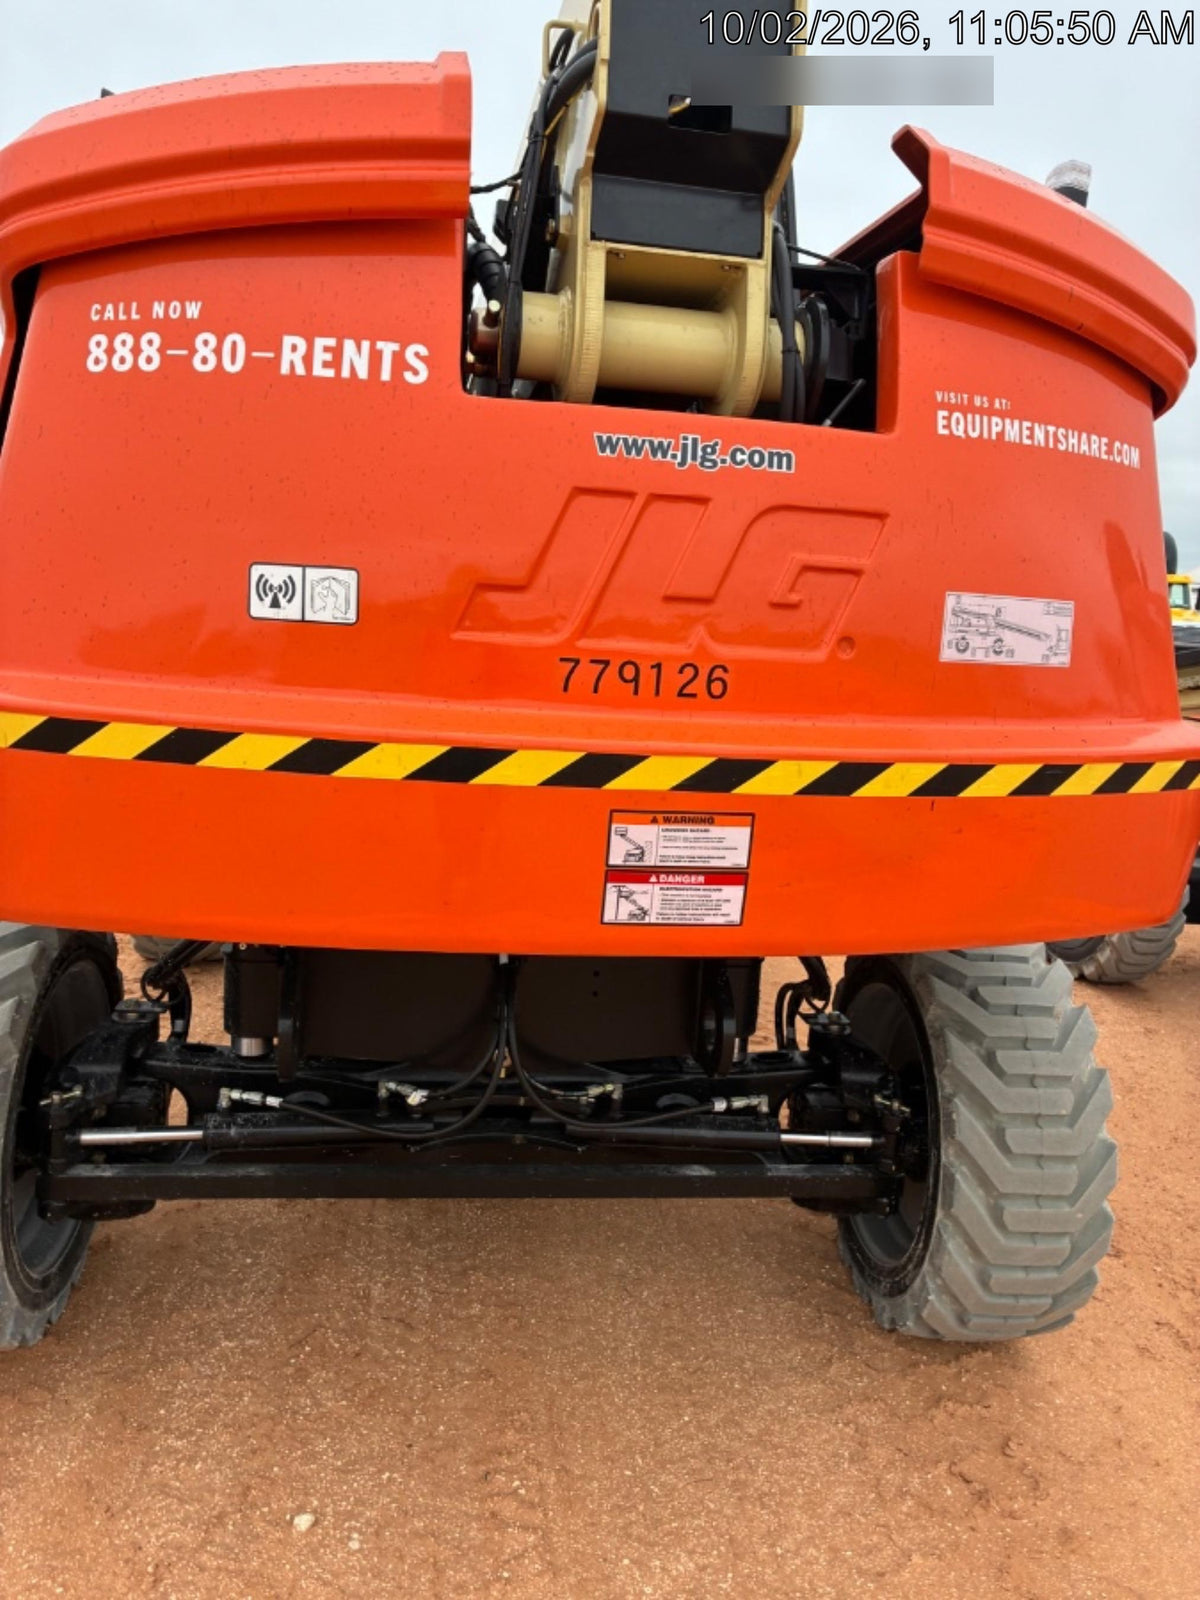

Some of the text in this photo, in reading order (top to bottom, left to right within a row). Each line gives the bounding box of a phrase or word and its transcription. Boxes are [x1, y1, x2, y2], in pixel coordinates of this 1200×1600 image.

[90, 301, 203, 321] CALL NOW
[86, 331, 430, 385] 888-80-RENTS
[935, 390, 1011, 411] VISIT US AT:
[594, 432, 795, 473] www.jlg.com
[936, 409, 1141, 470] EQUIPMENTSHARE.COM
[450, 486, 891, 663] JLG
[559, 657, 729, 700] 779126
[662, 815, 715, 825] WARNING
[659, 874, 706, 884] DANGER
